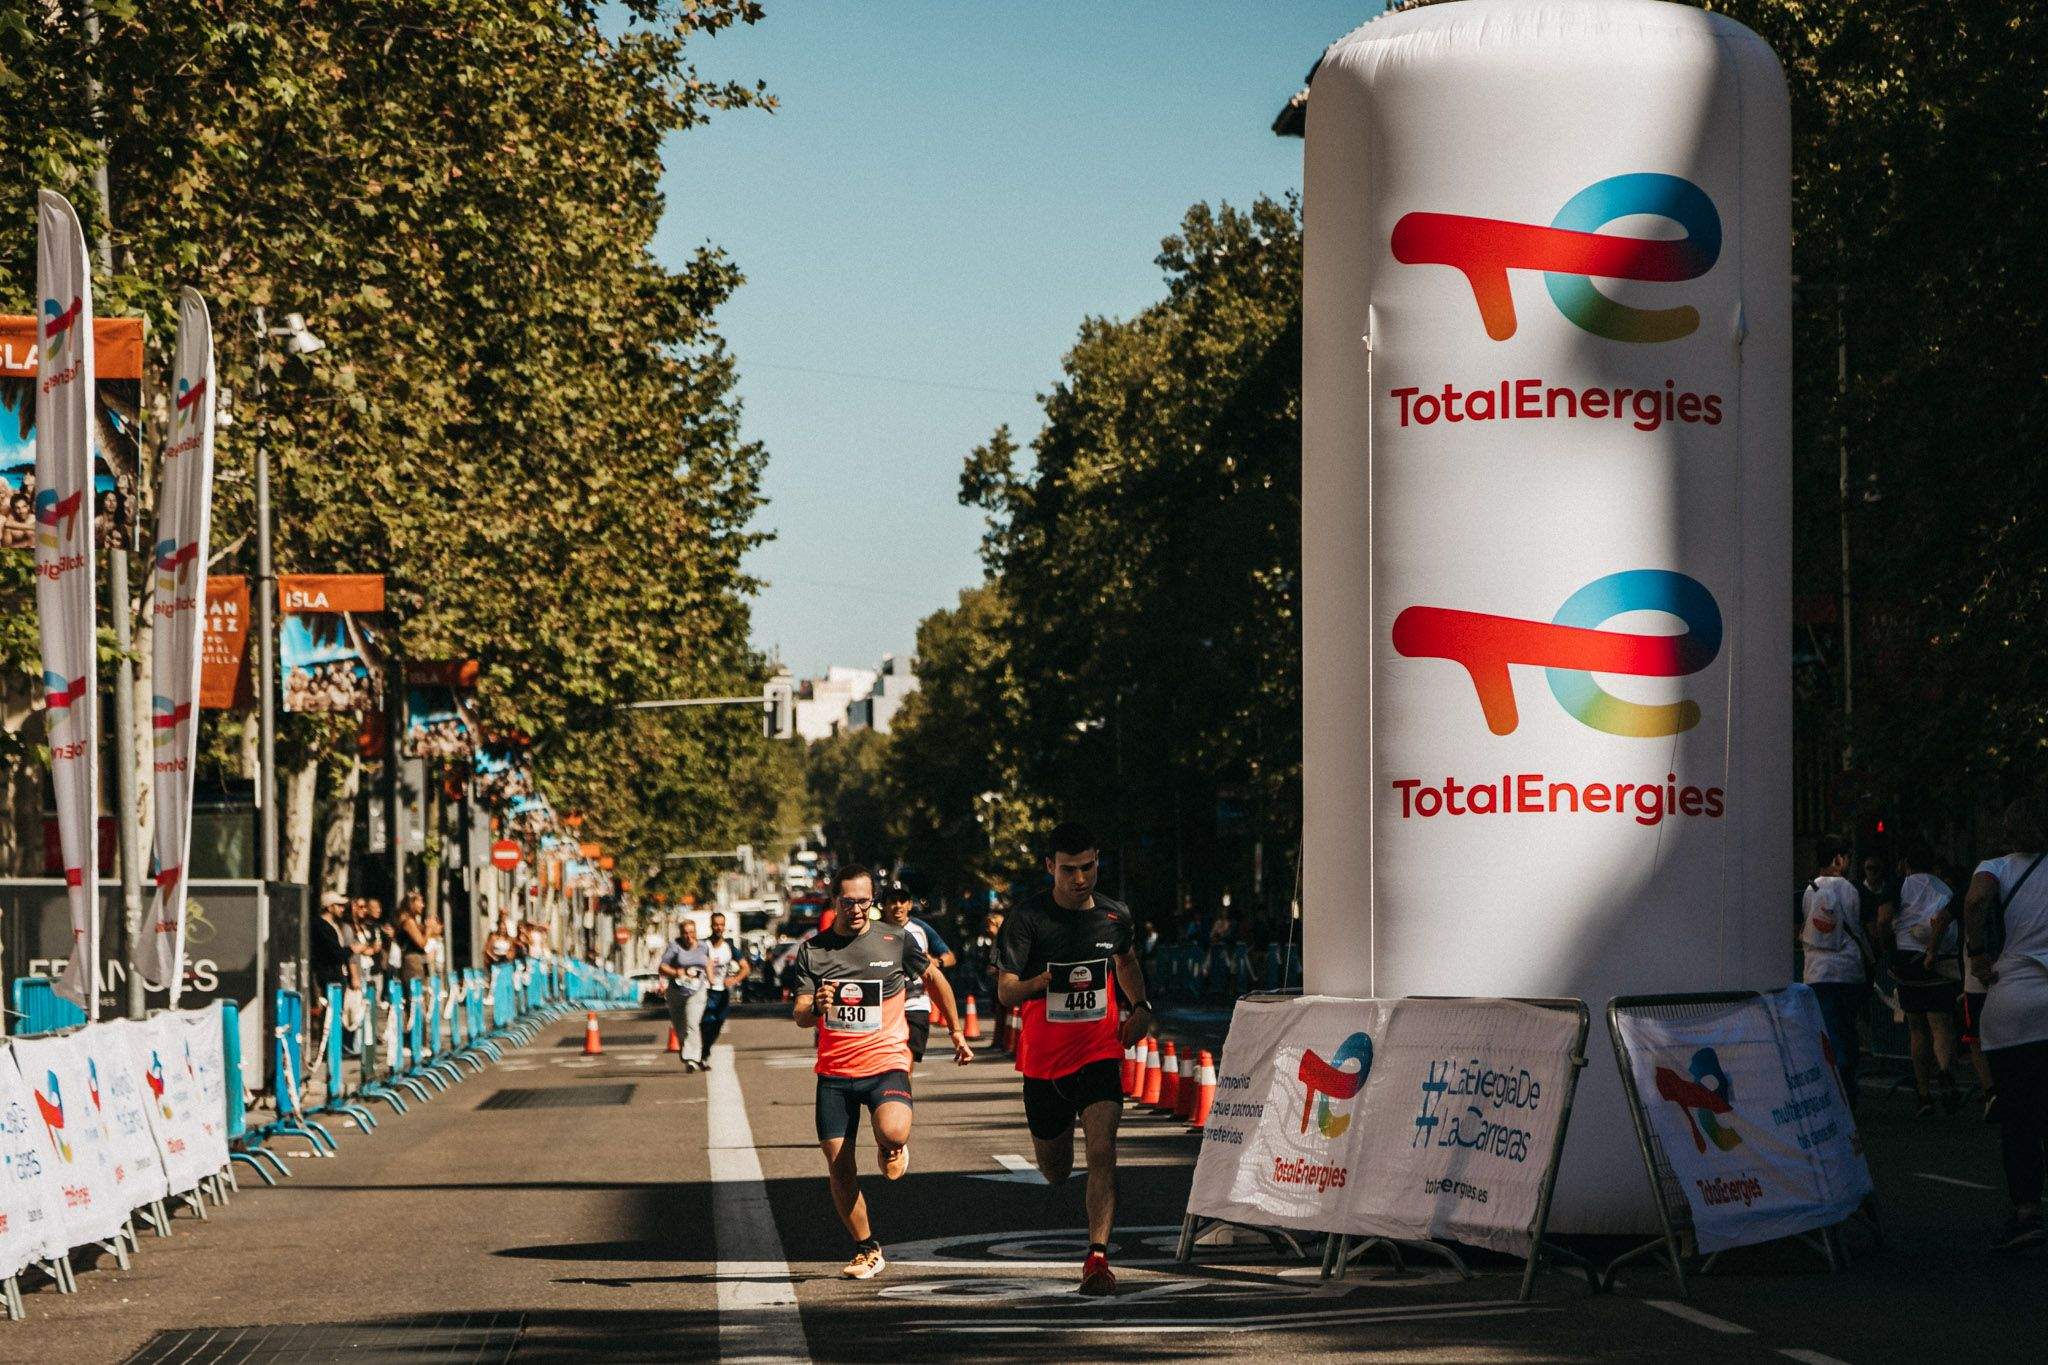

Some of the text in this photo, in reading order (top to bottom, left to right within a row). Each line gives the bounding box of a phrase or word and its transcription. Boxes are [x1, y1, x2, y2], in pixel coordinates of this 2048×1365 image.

[0, 343, 38, 369] LA
[1390, 379, 1723, 432] TotalEnergies
[285, 591, 329, 609] ISLA
[1392, 773, 1725, 826] TotalEnergies
[837, 1006, 866, 1022] 430
[1065, 991, 1097, 1011] 448
[1273, 1157, 1347, 1193] TotalEnergies
